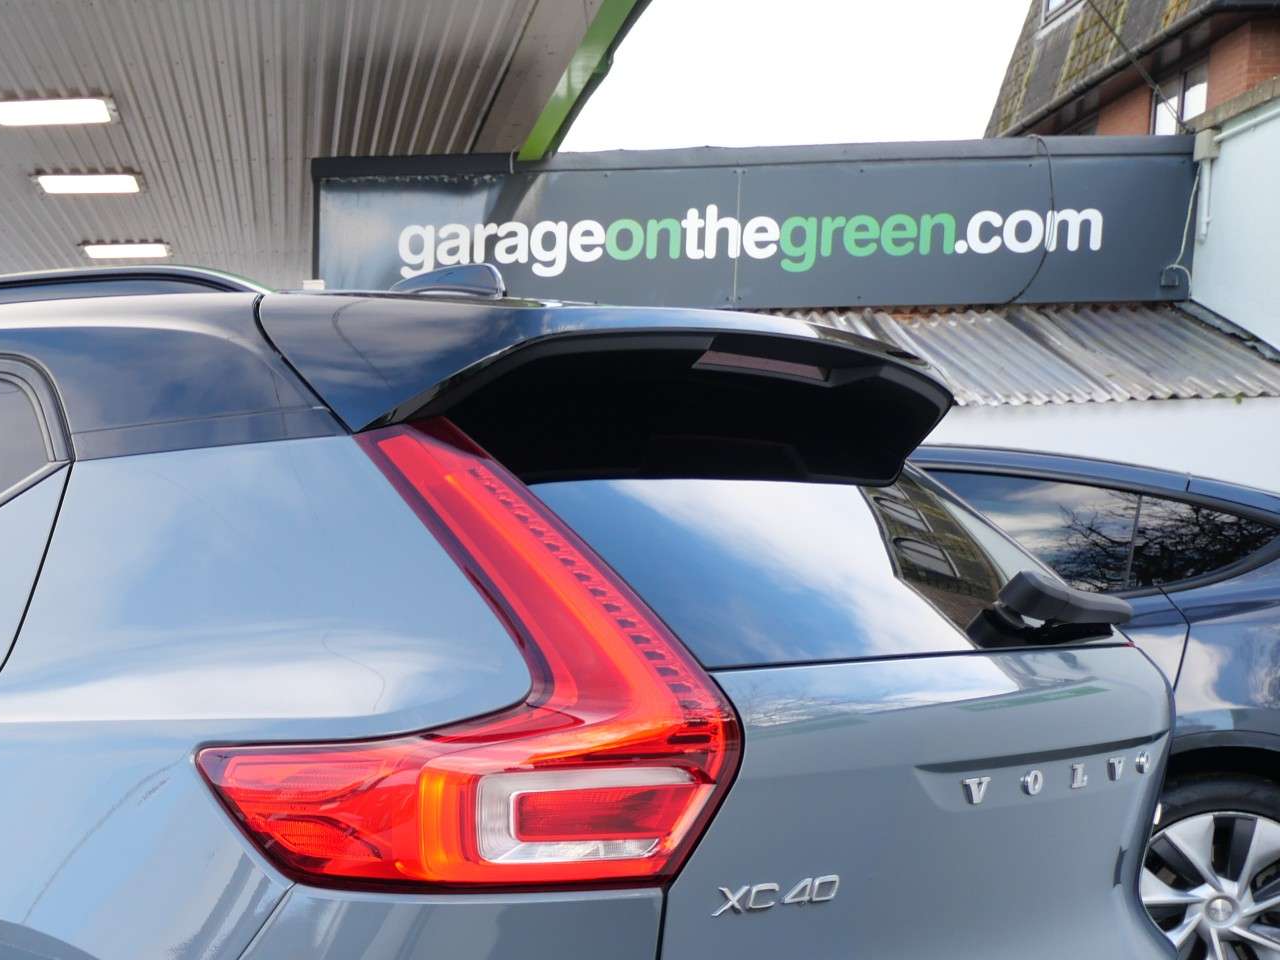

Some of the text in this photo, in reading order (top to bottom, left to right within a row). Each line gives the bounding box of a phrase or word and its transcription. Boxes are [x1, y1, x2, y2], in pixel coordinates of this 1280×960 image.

[398, 204, 1103, 279] garageonthegreen.com
[962, 751, 1150, 804] VOLVO
[711, 874, 840, 917] XC40
